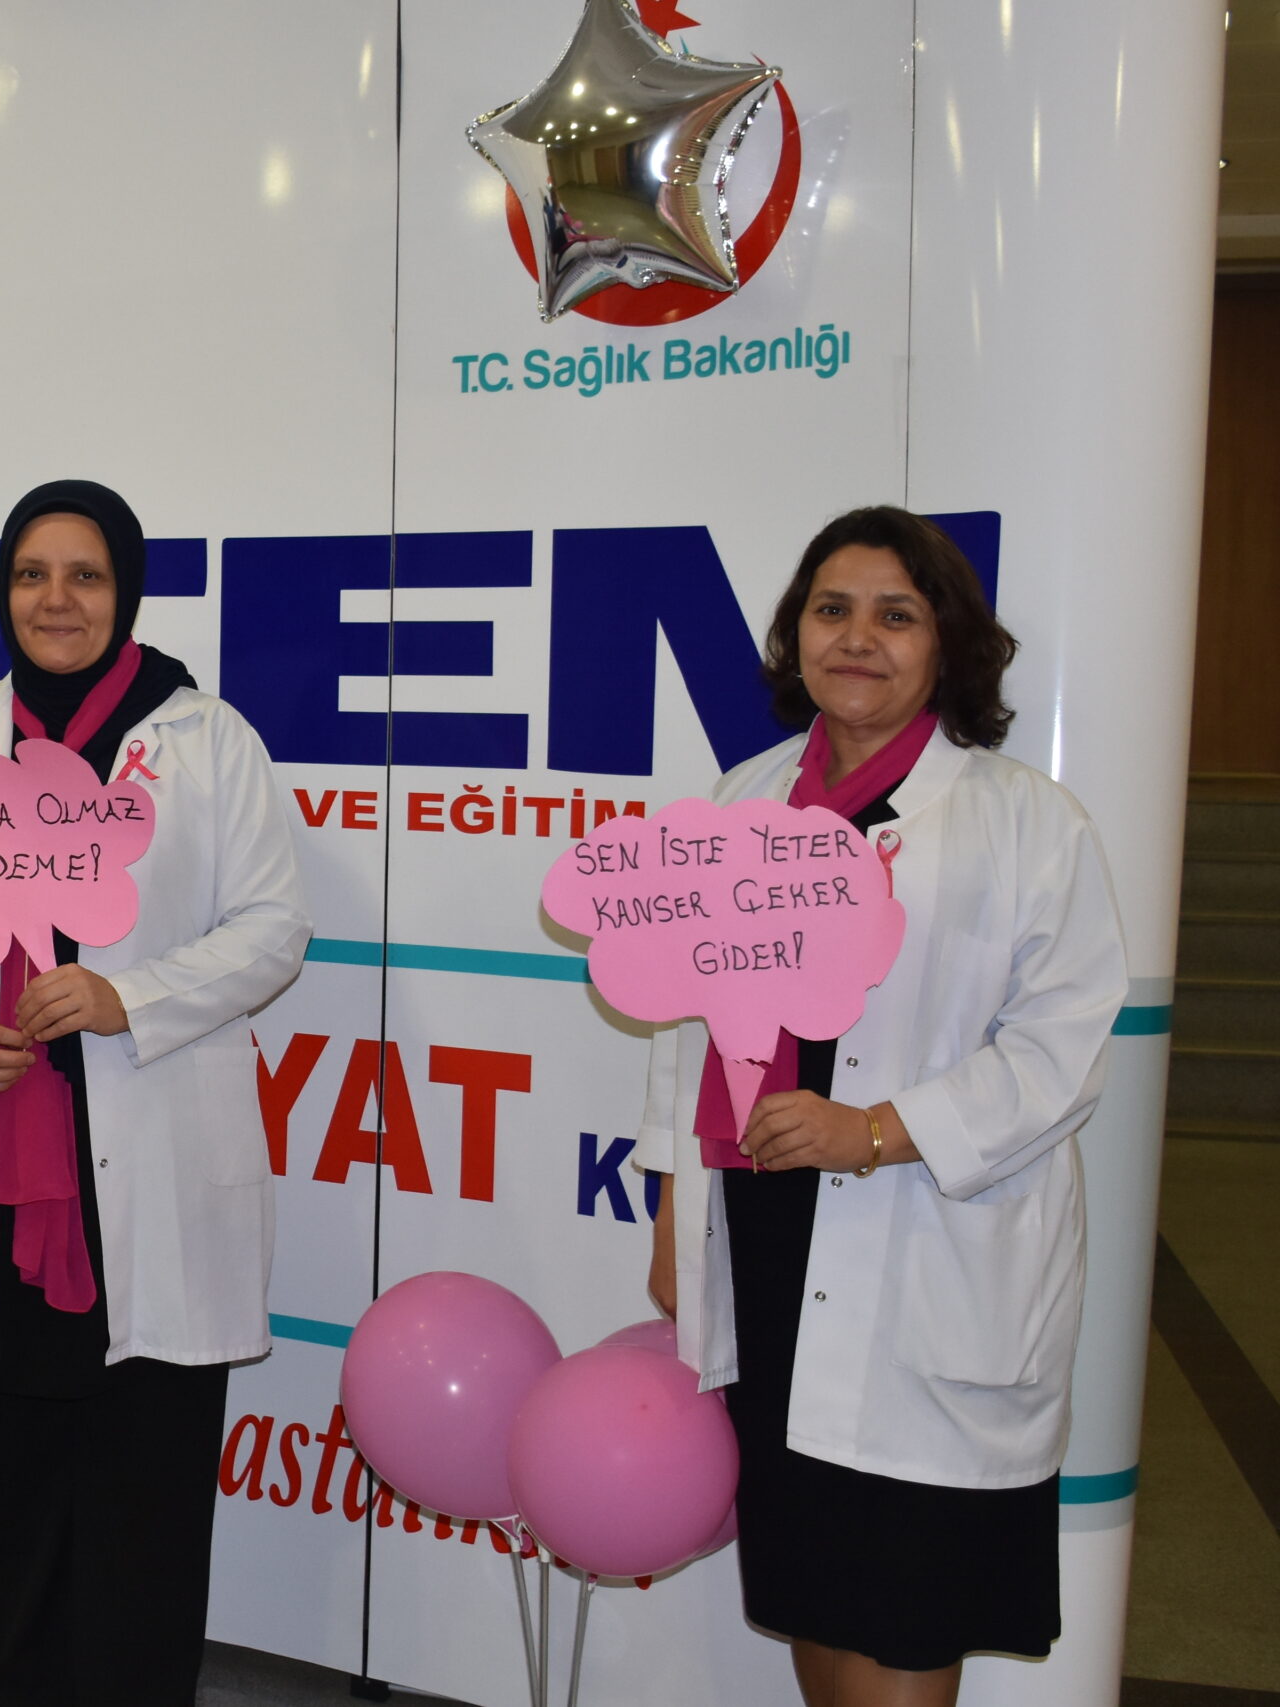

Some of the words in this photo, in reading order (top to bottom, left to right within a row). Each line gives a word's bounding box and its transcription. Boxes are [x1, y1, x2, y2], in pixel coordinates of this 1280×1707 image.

[452, 353, 514, 393] T.C.
[523, 344, 651, 398] Sağlık
[663, 323, 850, 380] Bakanlığı
[37, 793, 145, 825] OLMAZ
[293, 788, 378, 830] VE
[575, 842, 639, 876] SEN
[660, 826, 727, 867] İSTE
[750, 824, 859, 864] YETER
[592, 891, 711, 931] KANSER
[733, 877, 859, 915] ÇEKER
[693, 931, 803, 975] GİDER!
[250, 1029, 532, 1203] YAT
